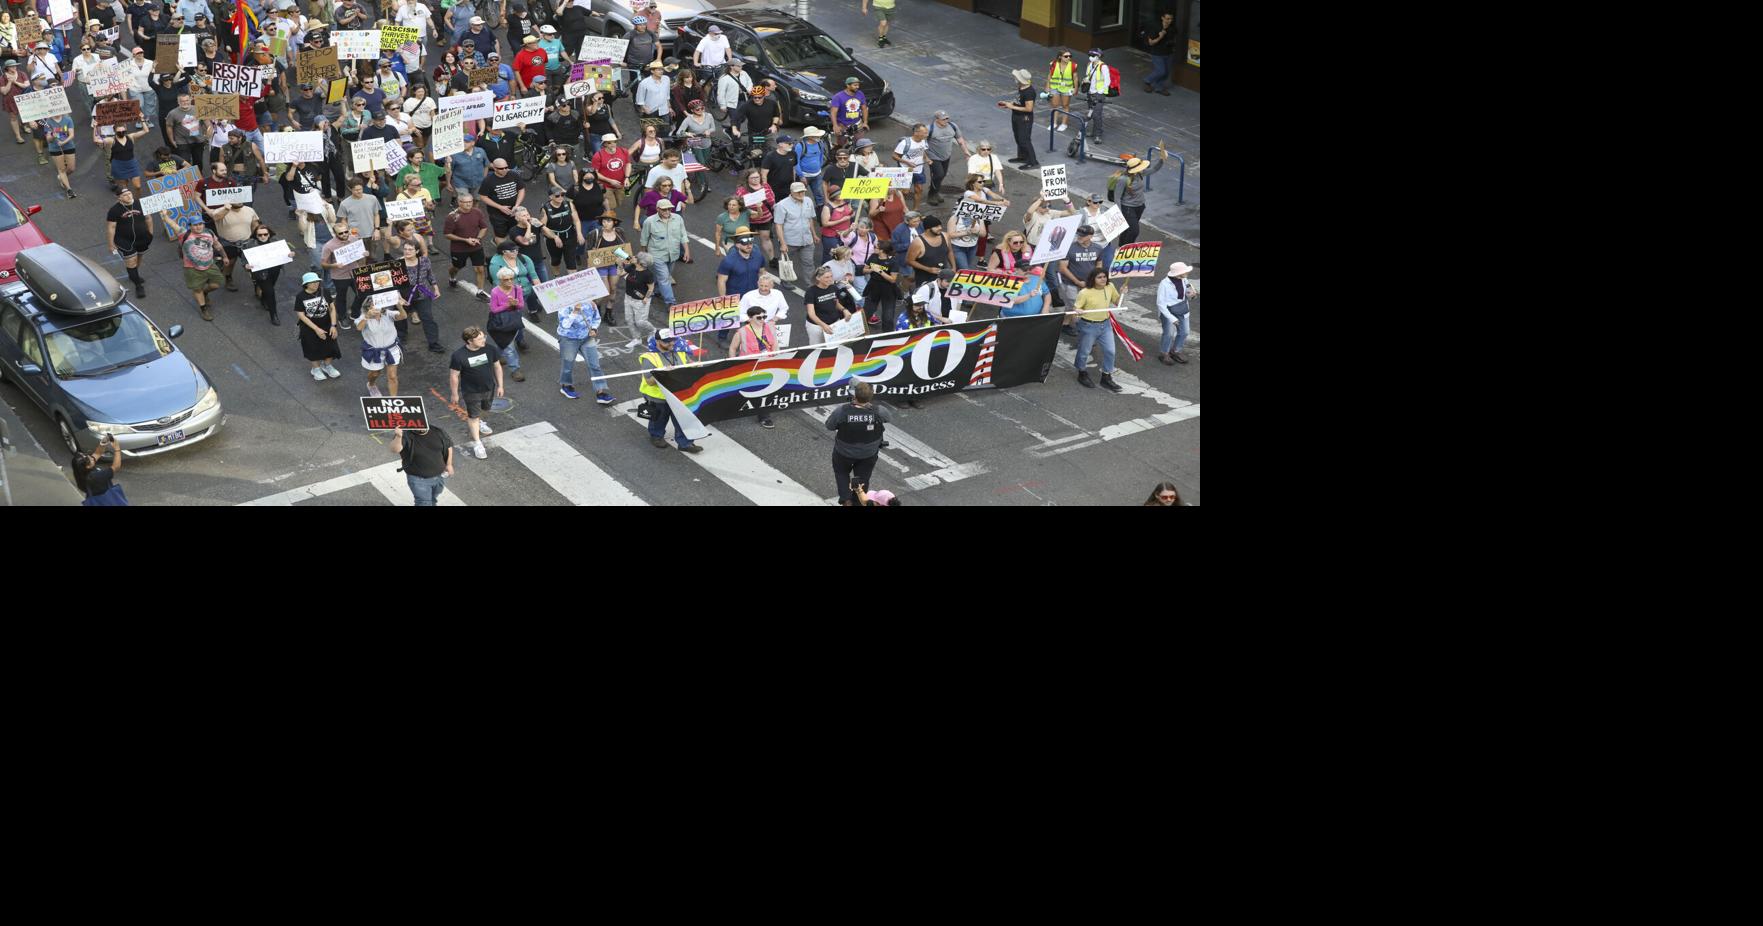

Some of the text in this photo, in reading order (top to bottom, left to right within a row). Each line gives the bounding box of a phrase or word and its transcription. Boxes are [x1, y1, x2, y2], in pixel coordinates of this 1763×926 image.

[381, 31, 409, 39] THRIVES
[382, 25, 418, 34] FASCISM
[213, 63, 261, 82] RESIST
[213, 78, 258, 95] TRUMP
[15, 87, 63, 103] JESUS SAID
[495, 102, 522, 113] VETS
[494, 108, 544, 123] OLIGARCHY!
[266, 151, 288, 162] OUR
[1043, 167, 1064, 177] SAVE US
[858, 179, 871, 187] NO
[1045, 177, 1066, 187] FROM
[212, 188, 242, 197] DONALD
[848, 186, 882, 195] TROOPS
[1045, 187, 1067, 198] FASCISM
[959, 201, 1002, 215] POWER
[956, 210, 1001, 222] PEOPLE
[1115, 243, 1160, 260] HUMBLE
[1111, 259, 1155, 277] BOYS
[955, 271, 1025, 290] HUMBLE
[947, 282, 1015, 304] BOYS
[672, 295, 738, 318] HUMBLE
[673, 311, 736, 336] BOYS
[739, 329, 967, 398] 5050
[739, 379, 956, 411] A Light in th Darkness
[381, 399, 405, 407] NO
[366, 406, 422, 414] HUMAN
[387, 412, 403, 420] IS
[849, 415, 873, 423] PRESS
[369, 419, 425, 428] ILLEGAL
